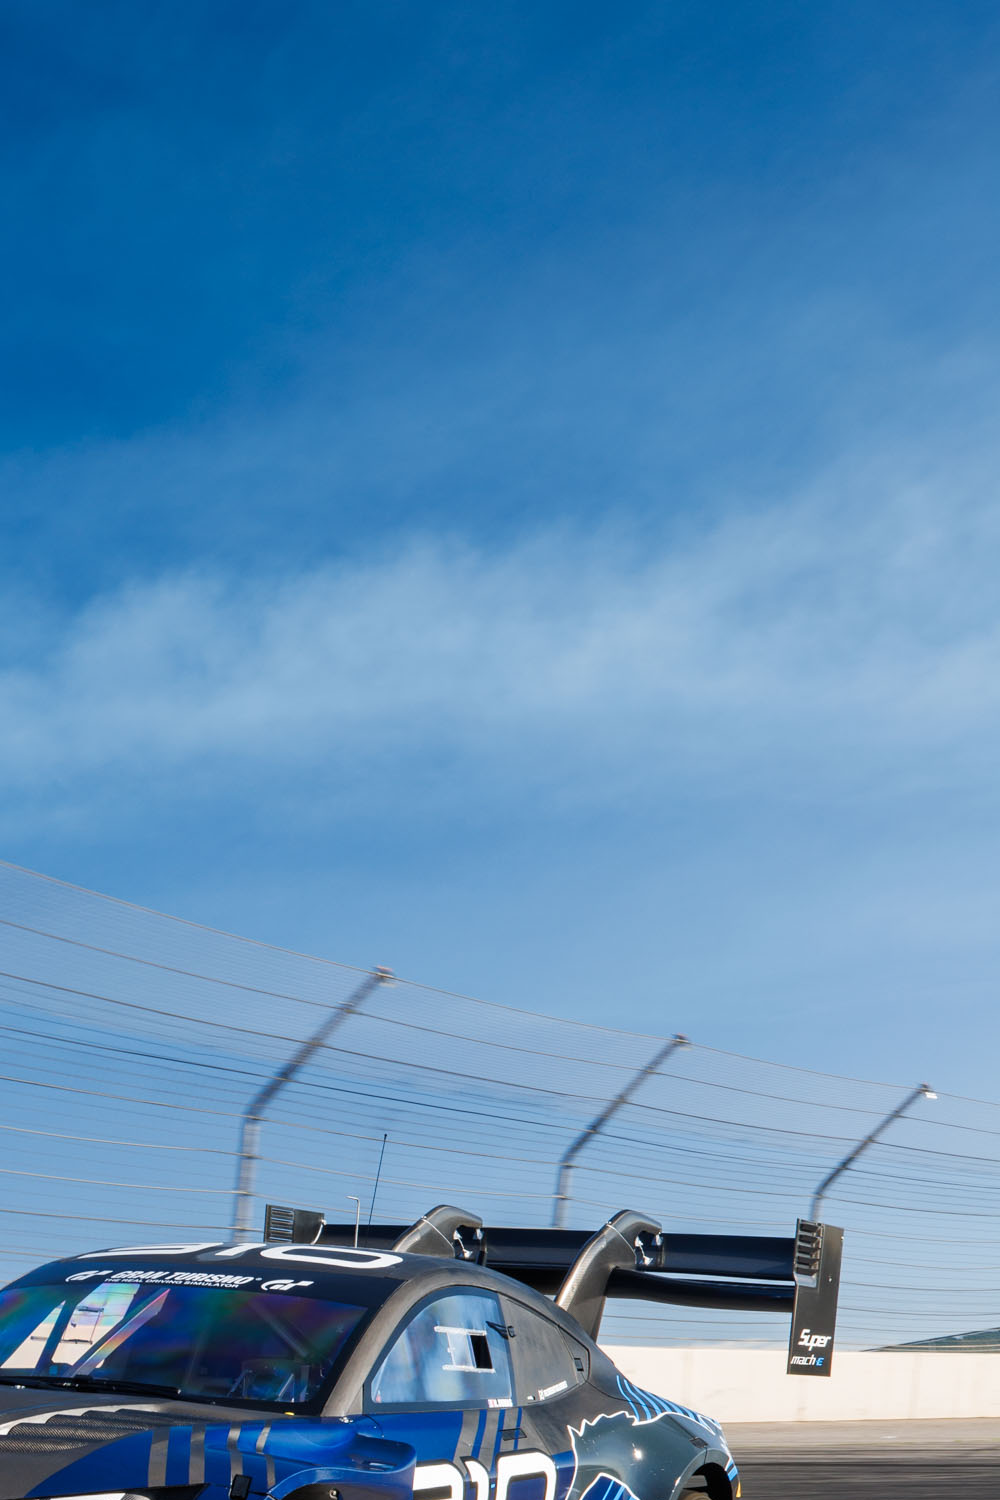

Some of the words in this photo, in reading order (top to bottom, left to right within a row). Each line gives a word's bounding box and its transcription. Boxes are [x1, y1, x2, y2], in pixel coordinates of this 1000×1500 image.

[77, 1242, 404, 1269] 310
[111, 1270, 170, 1280] GRAN
[165, 1272, 255, 1285] TURISMO
[183, 1280, 240, 1288] SIMULATOR
[797, 1328, 832, 1351] Super
